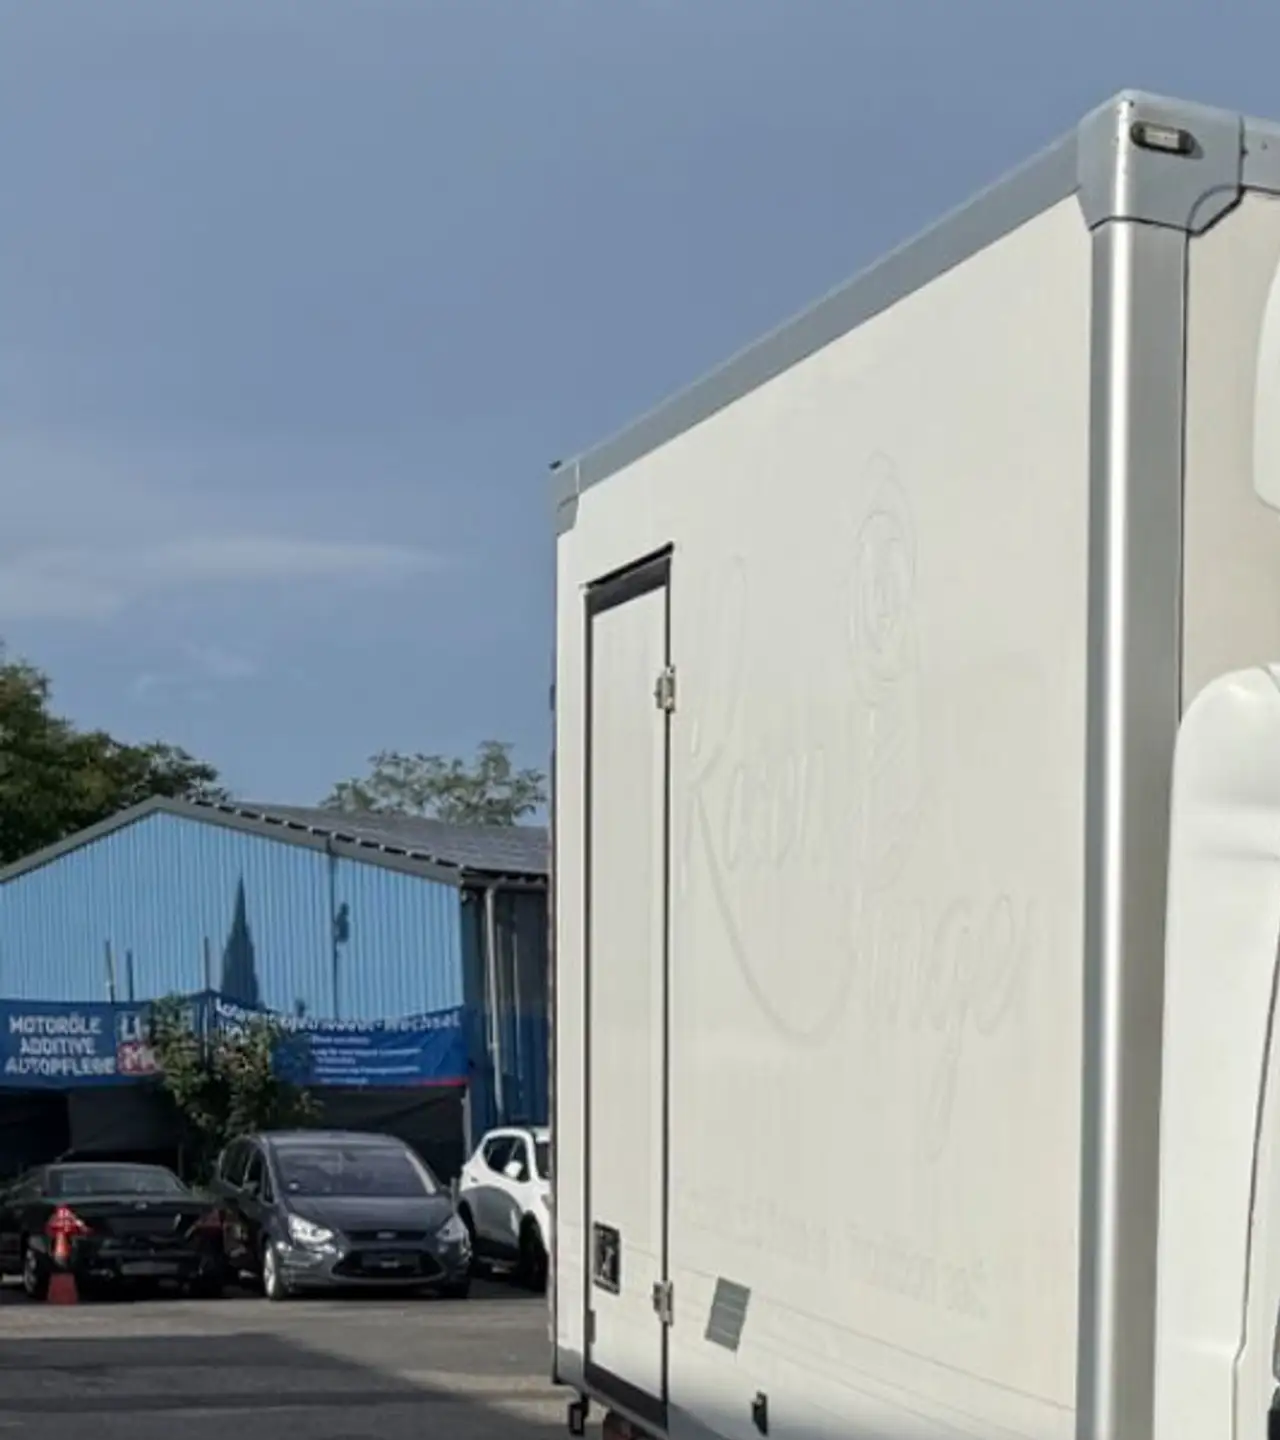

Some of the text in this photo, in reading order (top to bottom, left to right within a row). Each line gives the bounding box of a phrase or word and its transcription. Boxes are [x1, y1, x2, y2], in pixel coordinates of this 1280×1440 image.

[8, 1011, 102, 1034] MOTORÖLE
[20, 1035, 96, 1055] ADDITIVE
[4, 1056, 115, 1077] AUTOPFLEGE
